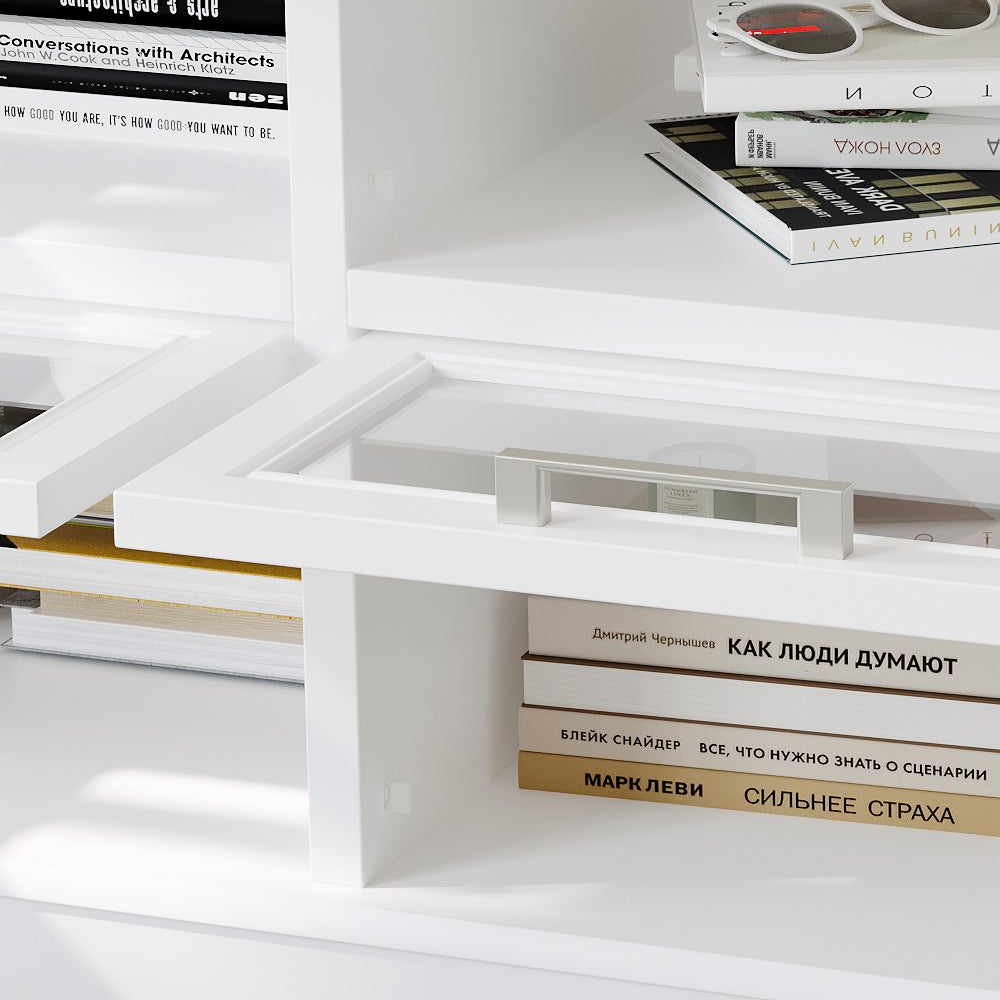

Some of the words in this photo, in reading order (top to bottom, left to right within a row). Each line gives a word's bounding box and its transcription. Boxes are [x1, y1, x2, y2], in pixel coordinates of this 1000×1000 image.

[0, 34, 129, 56] Conversations
[135, 46, 173, 60] with
[180, 48, 275, 68] Architects
[0, 47, 35, 59] John
[40, 50, 97, 64] W.Cook
[101, 57, 131, 67] and
[136, 59, 196, 72] Heinrich
[200, 63, 236, 76] Klotz
[228, 91, 284, 105] zen
[4, 105, 26, 118] HOW
[30, 107, 54, 121] GOOD
[59, 110, 78, 123] YOU
[83, 112, 104, 126] ARE,
[109, 114, 127, 127] IT'S
[131, 116, 153, 129] HOW
[157, 118, 182, 132] GOOD
[187, 120, 206, 134] YOU
[211, 123, 239, 137] WANT
[243, 125, 255, 138] TO
[260, 127, 276, 140] BE.
[592, 627, 647, 645] Дмитрий
[651, 631, 716, 650] Чернышев
[728, 637, 773, 659] КАК
[778, 641, 849, 668] ЛЮДИ
[855, 646, 958, 677] ДУМАЮТ
[560, 727, 608, 745] БЛЕЙК
[612, 731, 681, 752] СНАЙДЕР
[699, 741, 731, 759] ВСЕ,
[735, 745, 766, 760] ЧТО
[770, 748, 830, 766] НУЖНО
[833, 753, 881, 772] ЗНАТЬ
[885, 759, 899, 773] О
[902, 760, 988, 782] СЦЕНАРИИ
[584, 771, 644, 793] МАРК
[646, 777, 705, 798] ЛЕВИ
[743, 786, 857, 815] СИЛЬНЕЕ
[867, 798, 956, 826] СТРАХА
